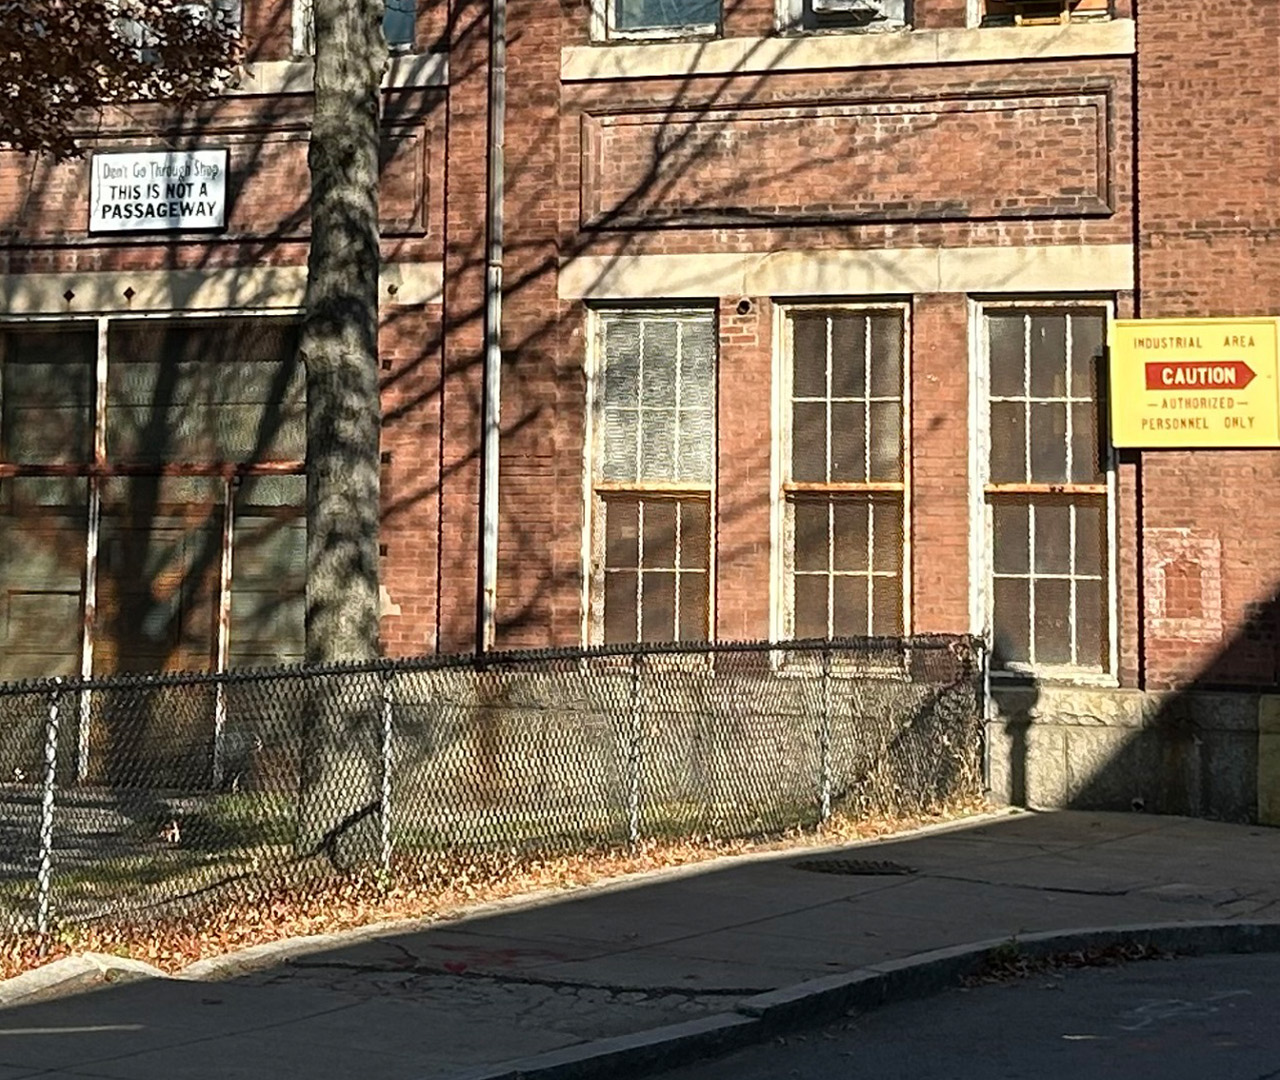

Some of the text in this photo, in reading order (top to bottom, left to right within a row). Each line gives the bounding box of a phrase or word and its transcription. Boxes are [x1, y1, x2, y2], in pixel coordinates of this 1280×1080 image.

[103, 162, 127, 179] Don't
[133, 162, 146, 178] Go
[150, 161, 191, 181] Through
[109, 182, 208, 200] THIS IS NOT A
[101, 201, 216, 219] PASSAGEWAY
[1133, 335, 1255, 349] INDUSTRIAL AREA
[1162, 366, 1236, 385] CAUTION
[1141, 416, 1255, 430] PERSONNEL ONLY
